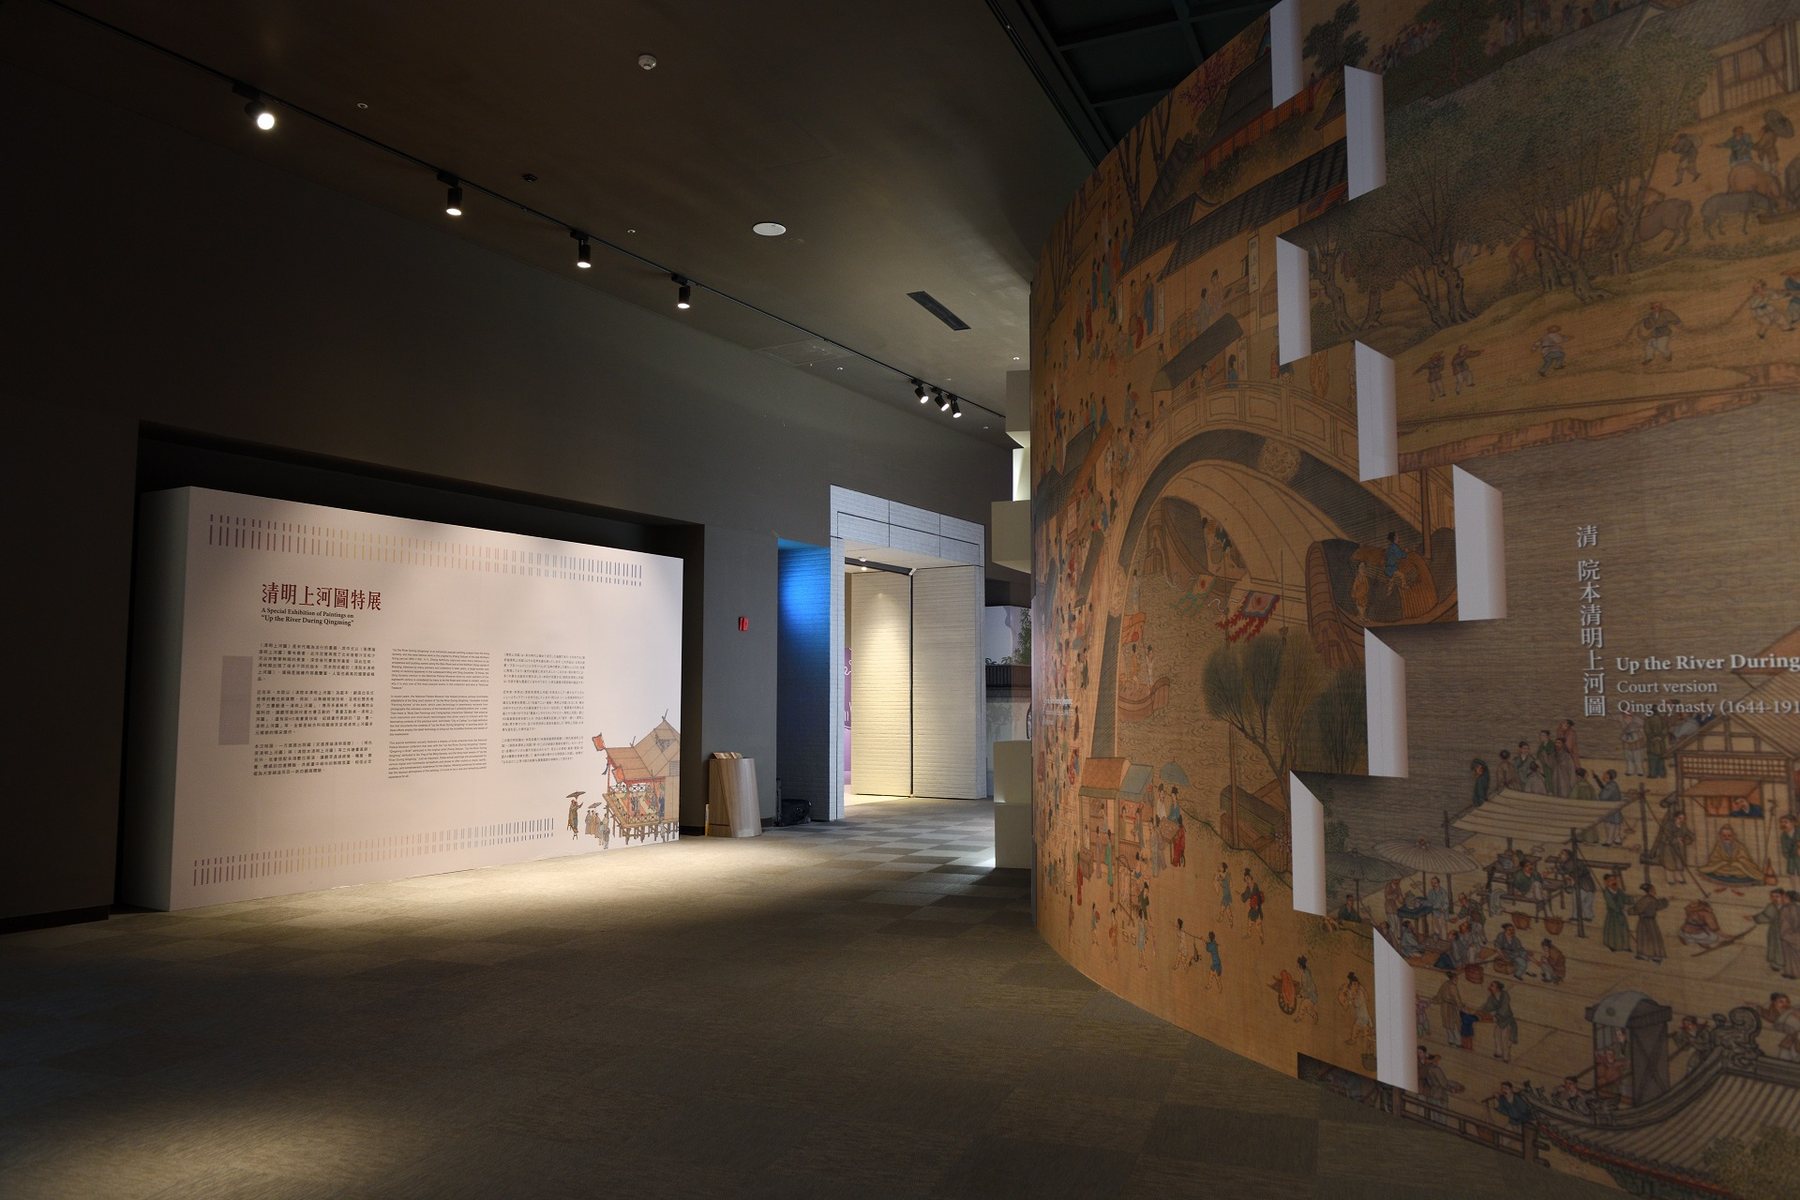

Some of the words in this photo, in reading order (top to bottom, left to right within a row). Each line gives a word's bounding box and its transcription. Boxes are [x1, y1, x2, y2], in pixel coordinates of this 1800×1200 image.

[1576, 525, 1598, 548] 清
[262, 582, 382, 611] 清明上河圖特展
[323, 611, 346, 619] Paintings
[1578, 559, 1606, 717] 院本清明上河圖
[1616, 657, 1640, 674] Up
[1644, 656, 1671, 670] the
[1676, 656, 1725, 670] River
[1730, 653, 1800, 672] During
[1617, 680, 1659, 693] Court
[1663, 682, 1718, 693] version
[1618, 699, 1654, 716] Qing
[1657, 699, 1715, 716] dynasty
